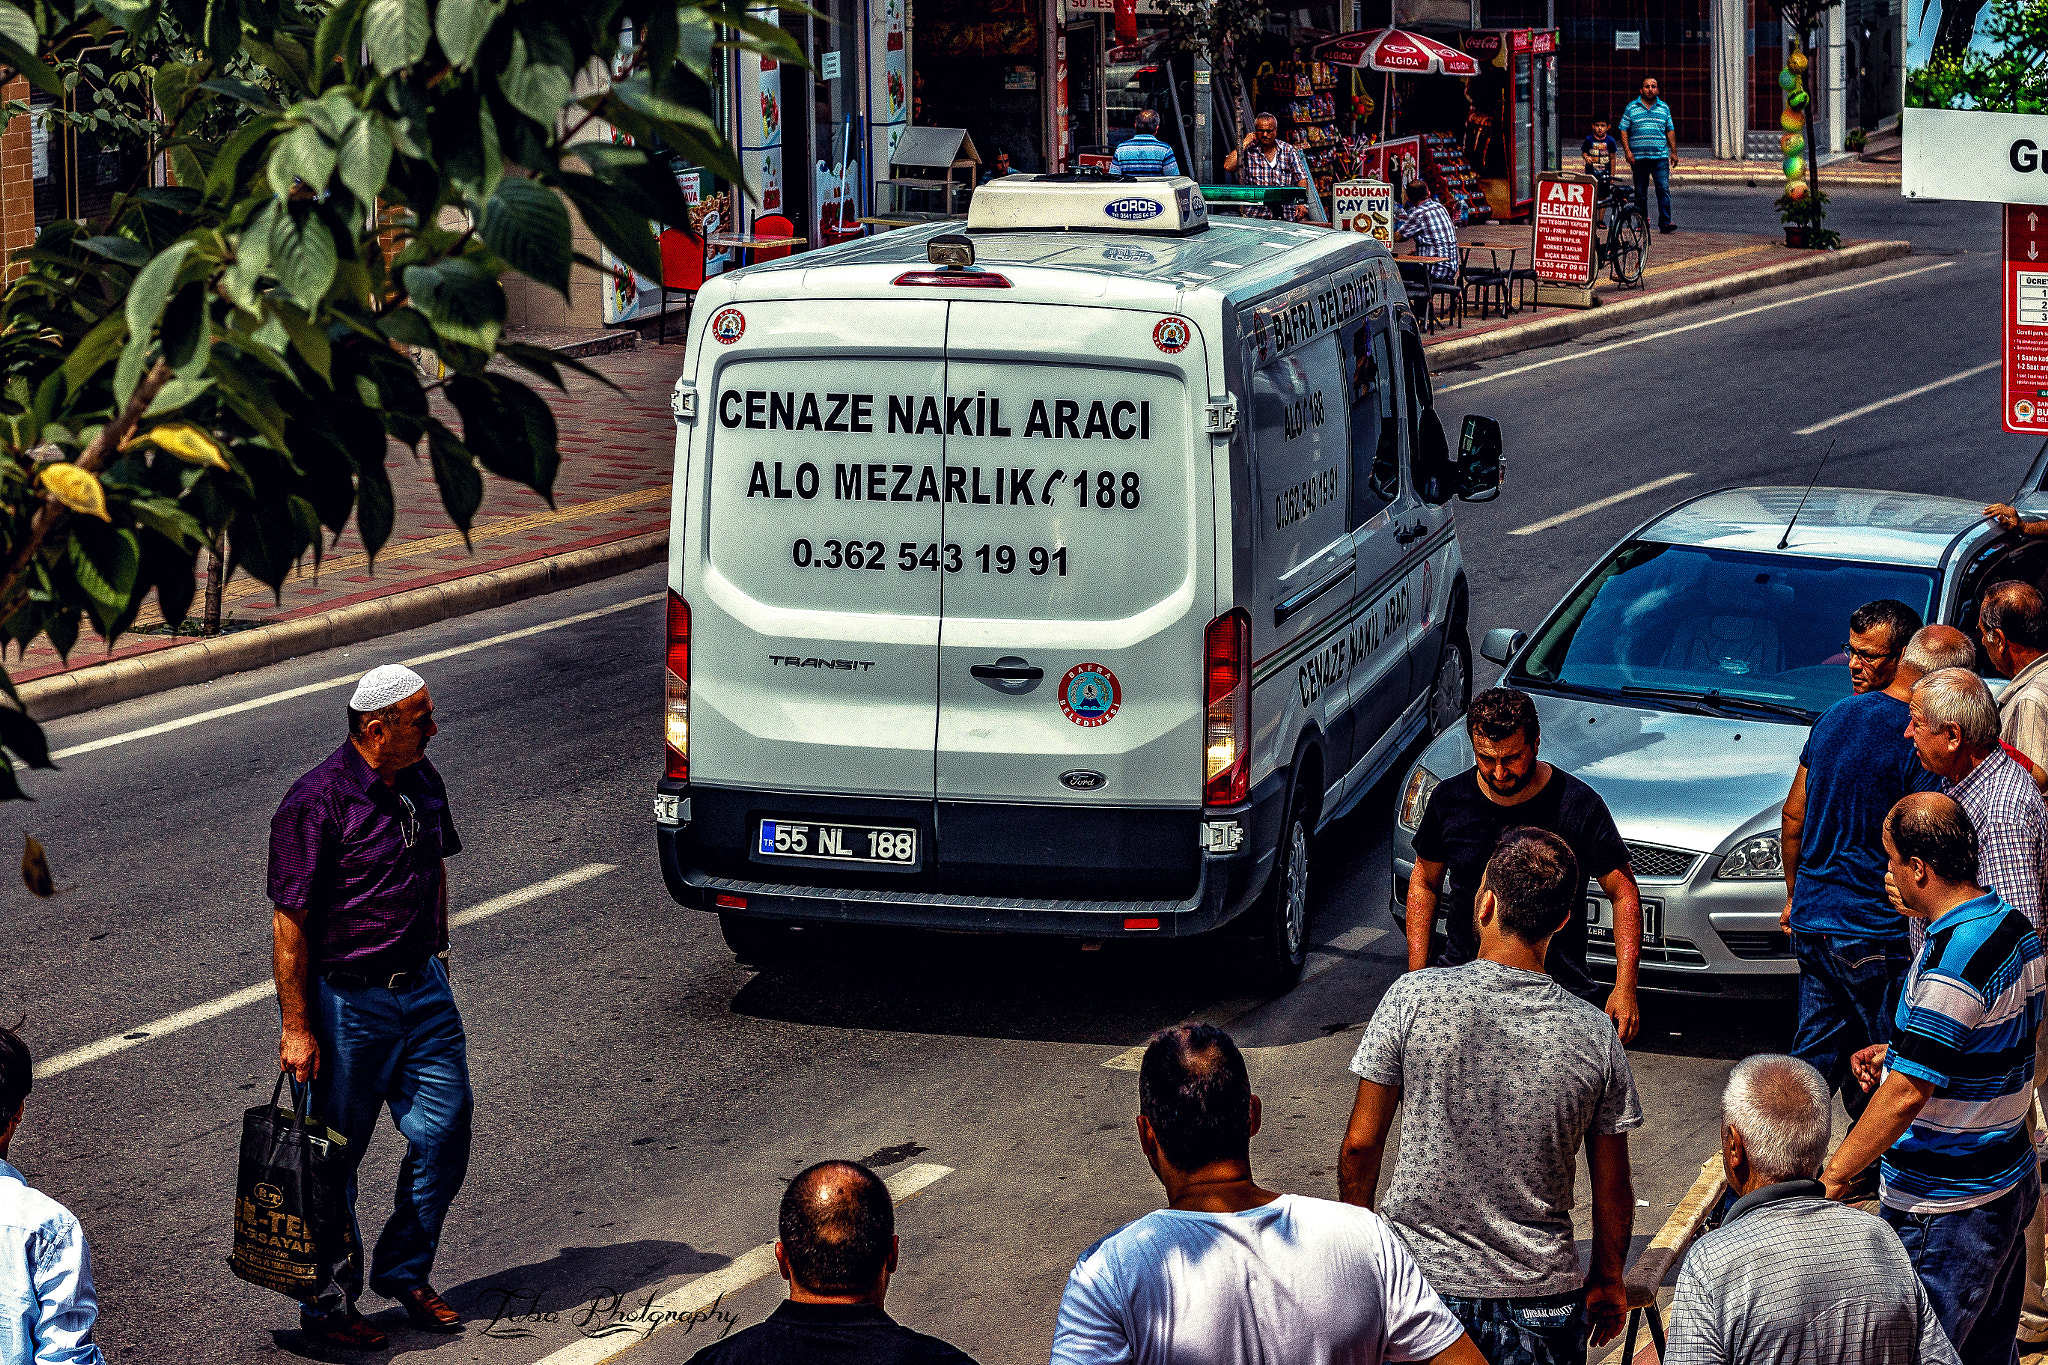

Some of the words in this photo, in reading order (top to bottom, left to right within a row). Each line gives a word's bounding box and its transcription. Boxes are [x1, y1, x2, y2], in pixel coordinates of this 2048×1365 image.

[1111, 199, 1157, 212] TOROS
[1335, 185, 1390, 197] DOĞUKAN
[1337, 200, 1364, 214] ÇAY
[1367, 197, 1389, 211] EVİ
[1547, 183, 1584, 203] AR
[1541, 202, 1590, 218] ELEKTRİK
[1271, 299, 1318, 352] BAFRA
[1318, 262, 1379, 331] BELEDİYESİ
[718, 389, 874, 433] CENAZE
[887, 390, 1012, 438] NAKİL
[1023, 399, 1151, 441] ARACI
[1309, 390, 1325, 430] 188
[746, 461, 821, 500] ALO
[833, 463, 1036, 507] MEZARLIK
[1073, 470, 1141, 510] 188
[1275, 485, 1300, 532] 0.362
[1301, 477, 1317, 517] 543
[1318, 471, 1328, 508] 19
[1329, 463, 1339, 501] 91
[792, 539, 887, 572] 0.362
[897, 542, 964, 573] 543
[975, 544, 1017, 575] 19
[1027, 546, 1069, 577] 91
[1299, 638, 1346, 709] CENAZE
[1348, 608, 1380, 672] NAKİL
[1382, 583, 1411, 643] ARACI
[768, 655, 875, 671] TRANSIT
[1068, 665, 1111, 680] BAFRA
[1060, 699, 1120, 728] BELEDİYESİ
[1070, 774, 1095, 787] Ford
[763, 838, 774, 848] TR
[775, 824, 809, 852] 55
[818, 828, 853, 856] NL
[867, 830, 912, 860] 188
